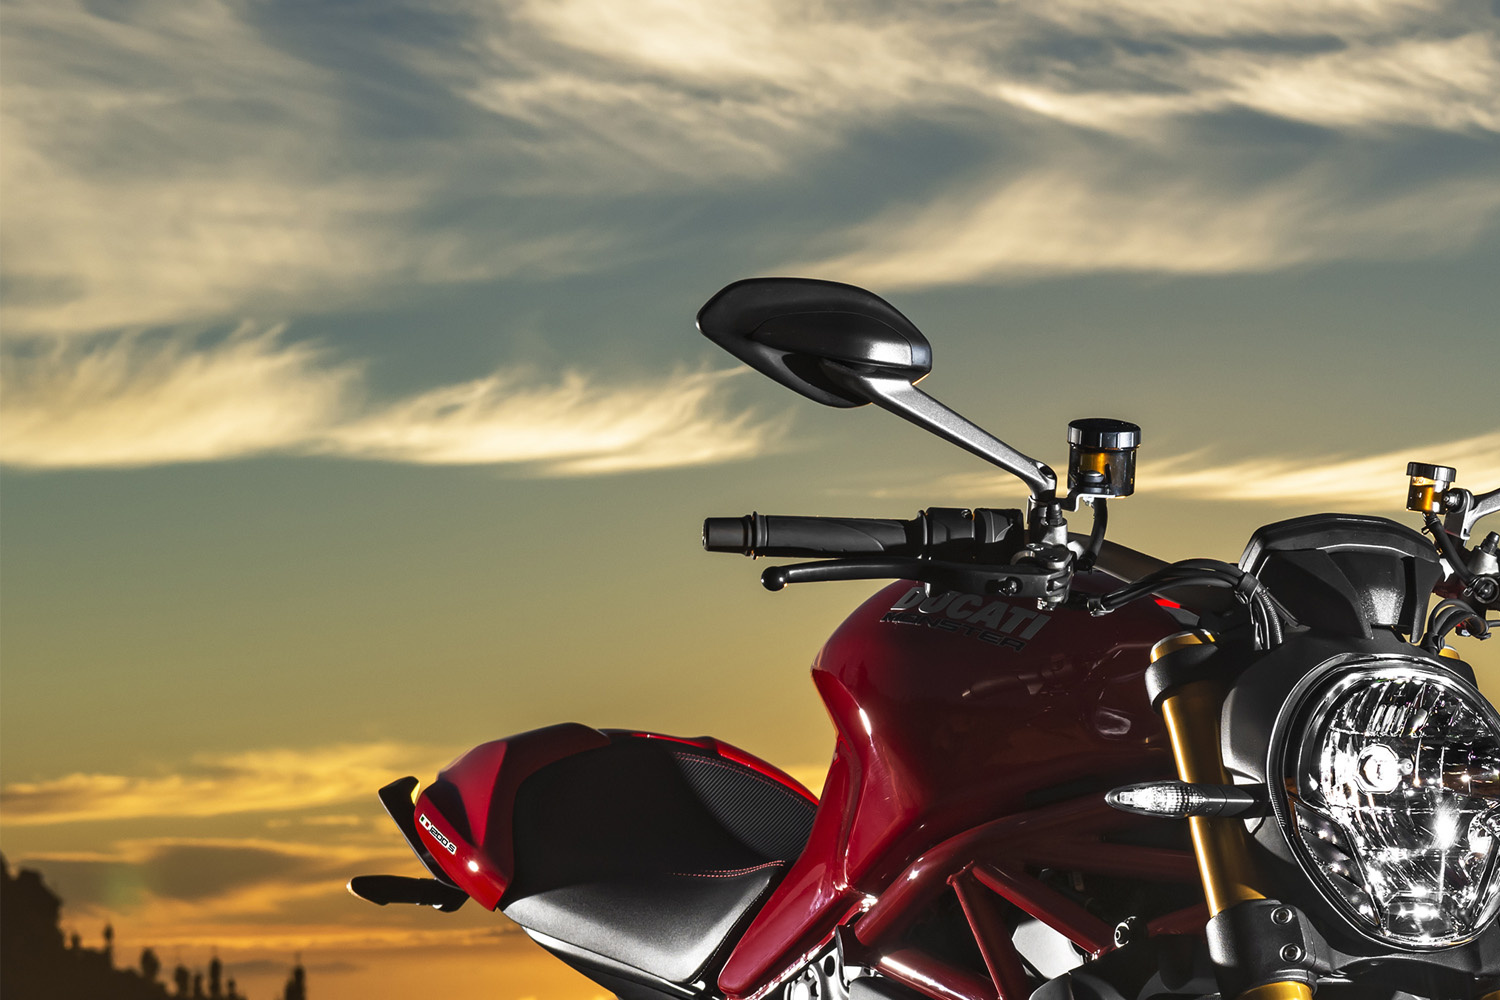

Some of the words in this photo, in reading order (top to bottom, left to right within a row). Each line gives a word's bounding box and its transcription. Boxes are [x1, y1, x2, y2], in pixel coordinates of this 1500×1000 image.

[880, 612, 1029, 651] MONSTER
[890, 586, 1051, 640] DUCATI
[447, 843, 456, 853] S
